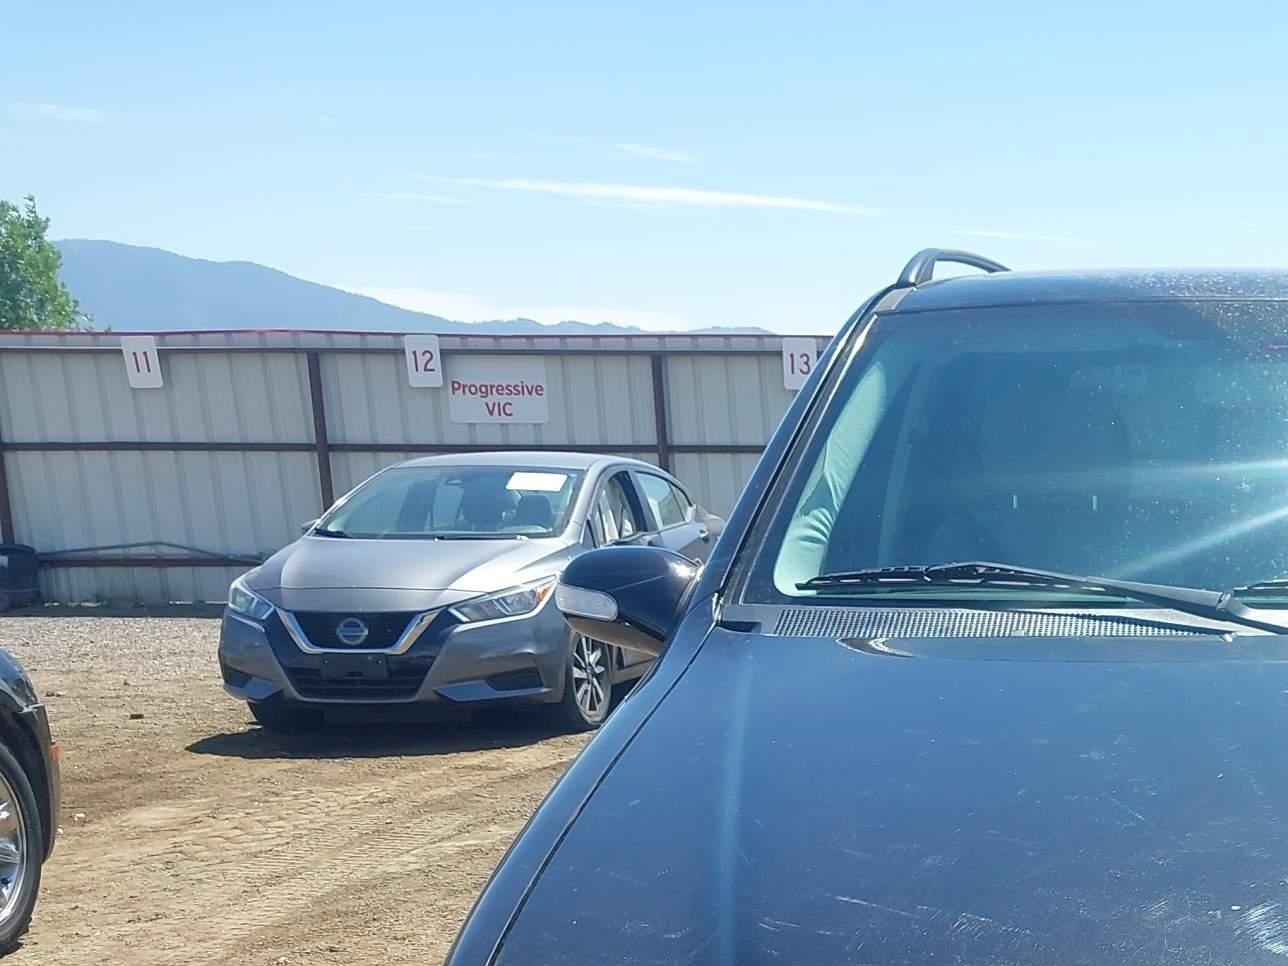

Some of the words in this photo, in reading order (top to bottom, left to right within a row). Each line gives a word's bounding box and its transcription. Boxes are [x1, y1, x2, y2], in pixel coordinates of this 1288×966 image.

[132, 351, 151, 373] 11
[411, 350, 436, 373] 12
[789, 353, 811, 375] 13
[450, 381, 544, 398] Progressive
[485, 402, 513, 417] VIC
